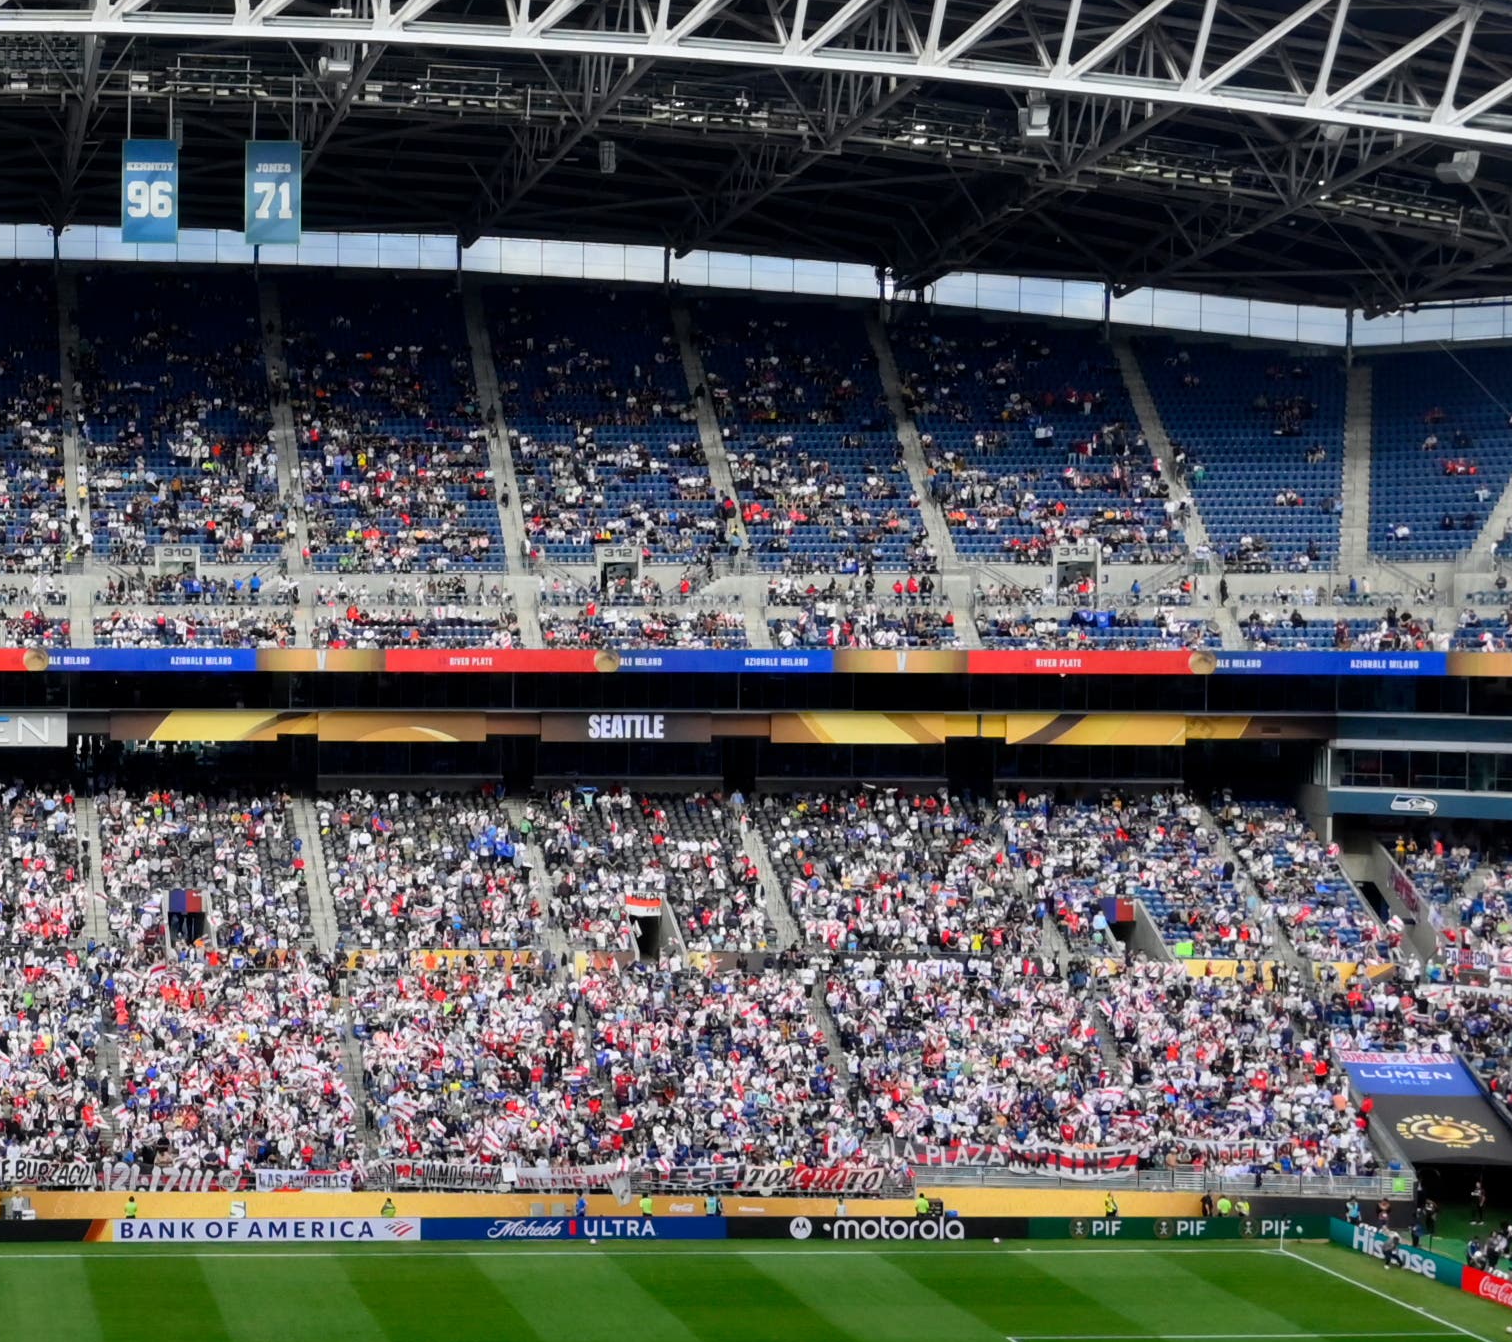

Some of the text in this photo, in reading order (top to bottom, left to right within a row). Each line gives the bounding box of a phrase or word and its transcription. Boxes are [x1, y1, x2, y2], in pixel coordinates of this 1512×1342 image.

[255, 162, 292, 173] JONES
[127, 180, 173, 218] 96
[253, 181, 293, 219] 71
[163, 547, 194, 557] 310
[603, 547, 634, 557] 312
[1058, 546, 1091, 557] 314
[450, 657, 493, 666] RIVER PLATE
[588, 714, 665, 739] SEATTLE
[1359, 1069, 1453, 1080] LUMEN
[925, 1145, 1006, 1166] PLAZA
[119, 1220, 375, 1240] BANK OF AMERICA
[486, 1219, 656, 1241] Michelob ULTRA
[832, 1216, 965, 1241] motorola
[1092, 1219, 1122, 1236] PIF
[1176, 1219, 1207, 1236] PIF
[1260, 1219, 1292, 1236] PIF
[1352, 1223, 1437, 1281] Hisnse
